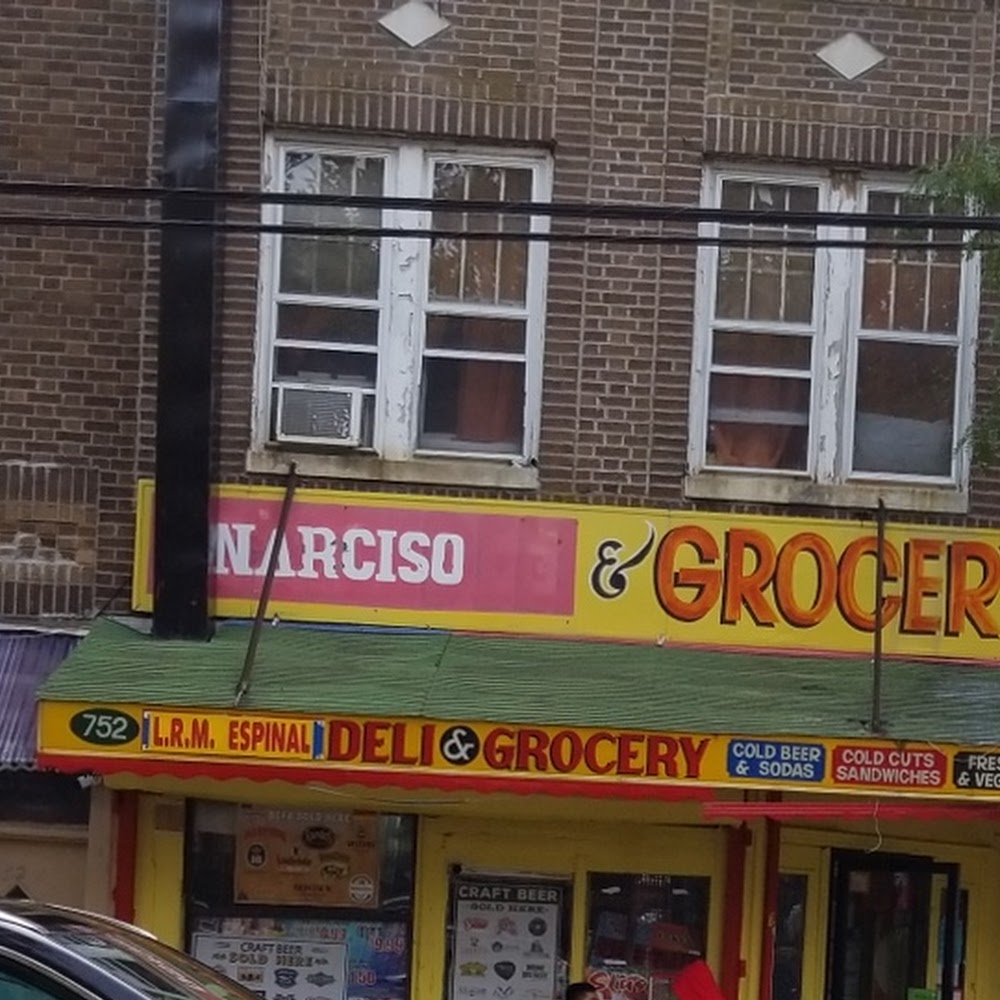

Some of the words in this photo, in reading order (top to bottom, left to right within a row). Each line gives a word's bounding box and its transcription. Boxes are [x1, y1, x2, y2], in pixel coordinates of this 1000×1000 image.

[209, 522, 465, 585] NARCISO
[590, 520, 656, 600] &
[82, 713, 129, 741] 752
[153, 716, 216, 749] L.R.M.
[228, 720, 310, 754] ESPINAL
[328, 719, 436, 767] DELI
[444, 727, 475, 763] &
[482, 727, 711, 779] GROCERY
[732, 742, 777, 759] COLD
[780, 745, 822, 763] BEER
[841, 748, 885, 766] COLD
[888, 751, 935, 768] CUTS
[735, 760, 750, 776] &
[759, 760, 815, 779] SODAS
[836, 765, 942, 786] SANDWICHES
[957, 771, 971, 787] &
[459, 886, 510, 899] CRAFT
[517, 889, 559, 901] BEER
[240, 942, 275, 954] CRAFT
[276, 944, 303, 955] BEER
[228, 953, 269, 965] SOLD
[275, 955, 313, 968] HERE
